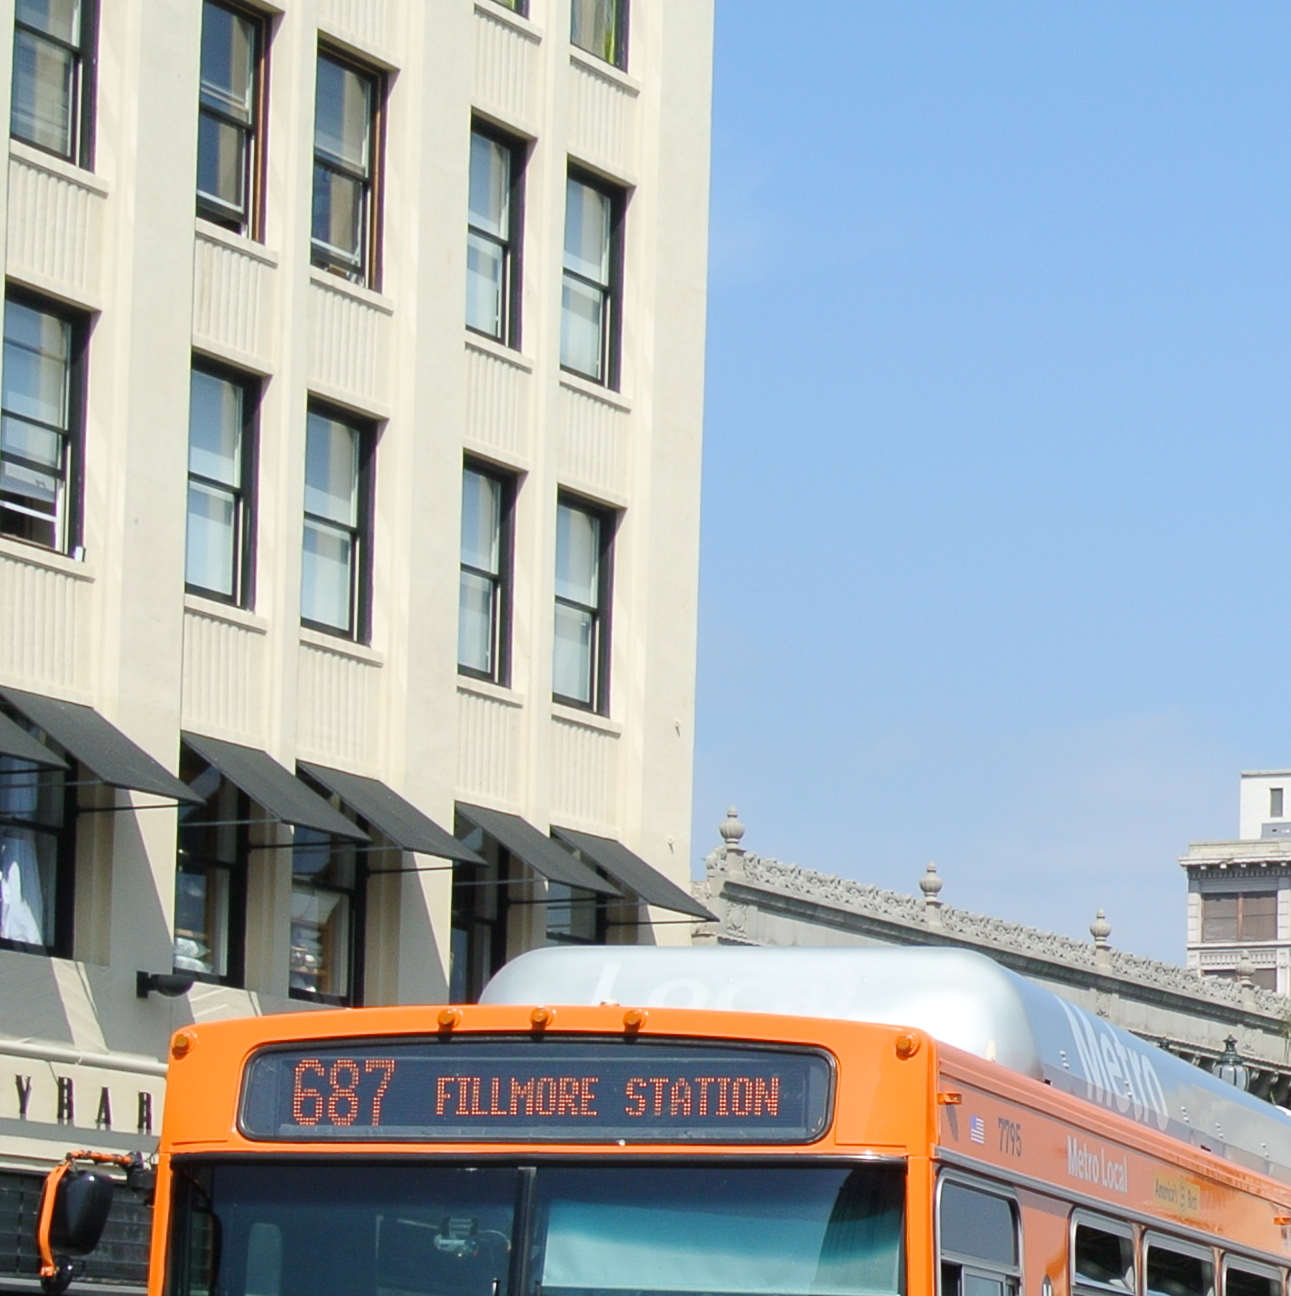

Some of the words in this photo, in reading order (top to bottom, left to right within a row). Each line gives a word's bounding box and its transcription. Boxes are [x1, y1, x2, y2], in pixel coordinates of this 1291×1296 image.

[293, 1058, 396, 1127] 687
[436, 1076, 599, 1117] FILLMORE
[624, 1076, 779, 1117] STATION
[998, 1117, 1022, 1156] 7795
[1067, 1135, 1099, 1183] Metro
[1101, 1148, 1128, 1193] Local
